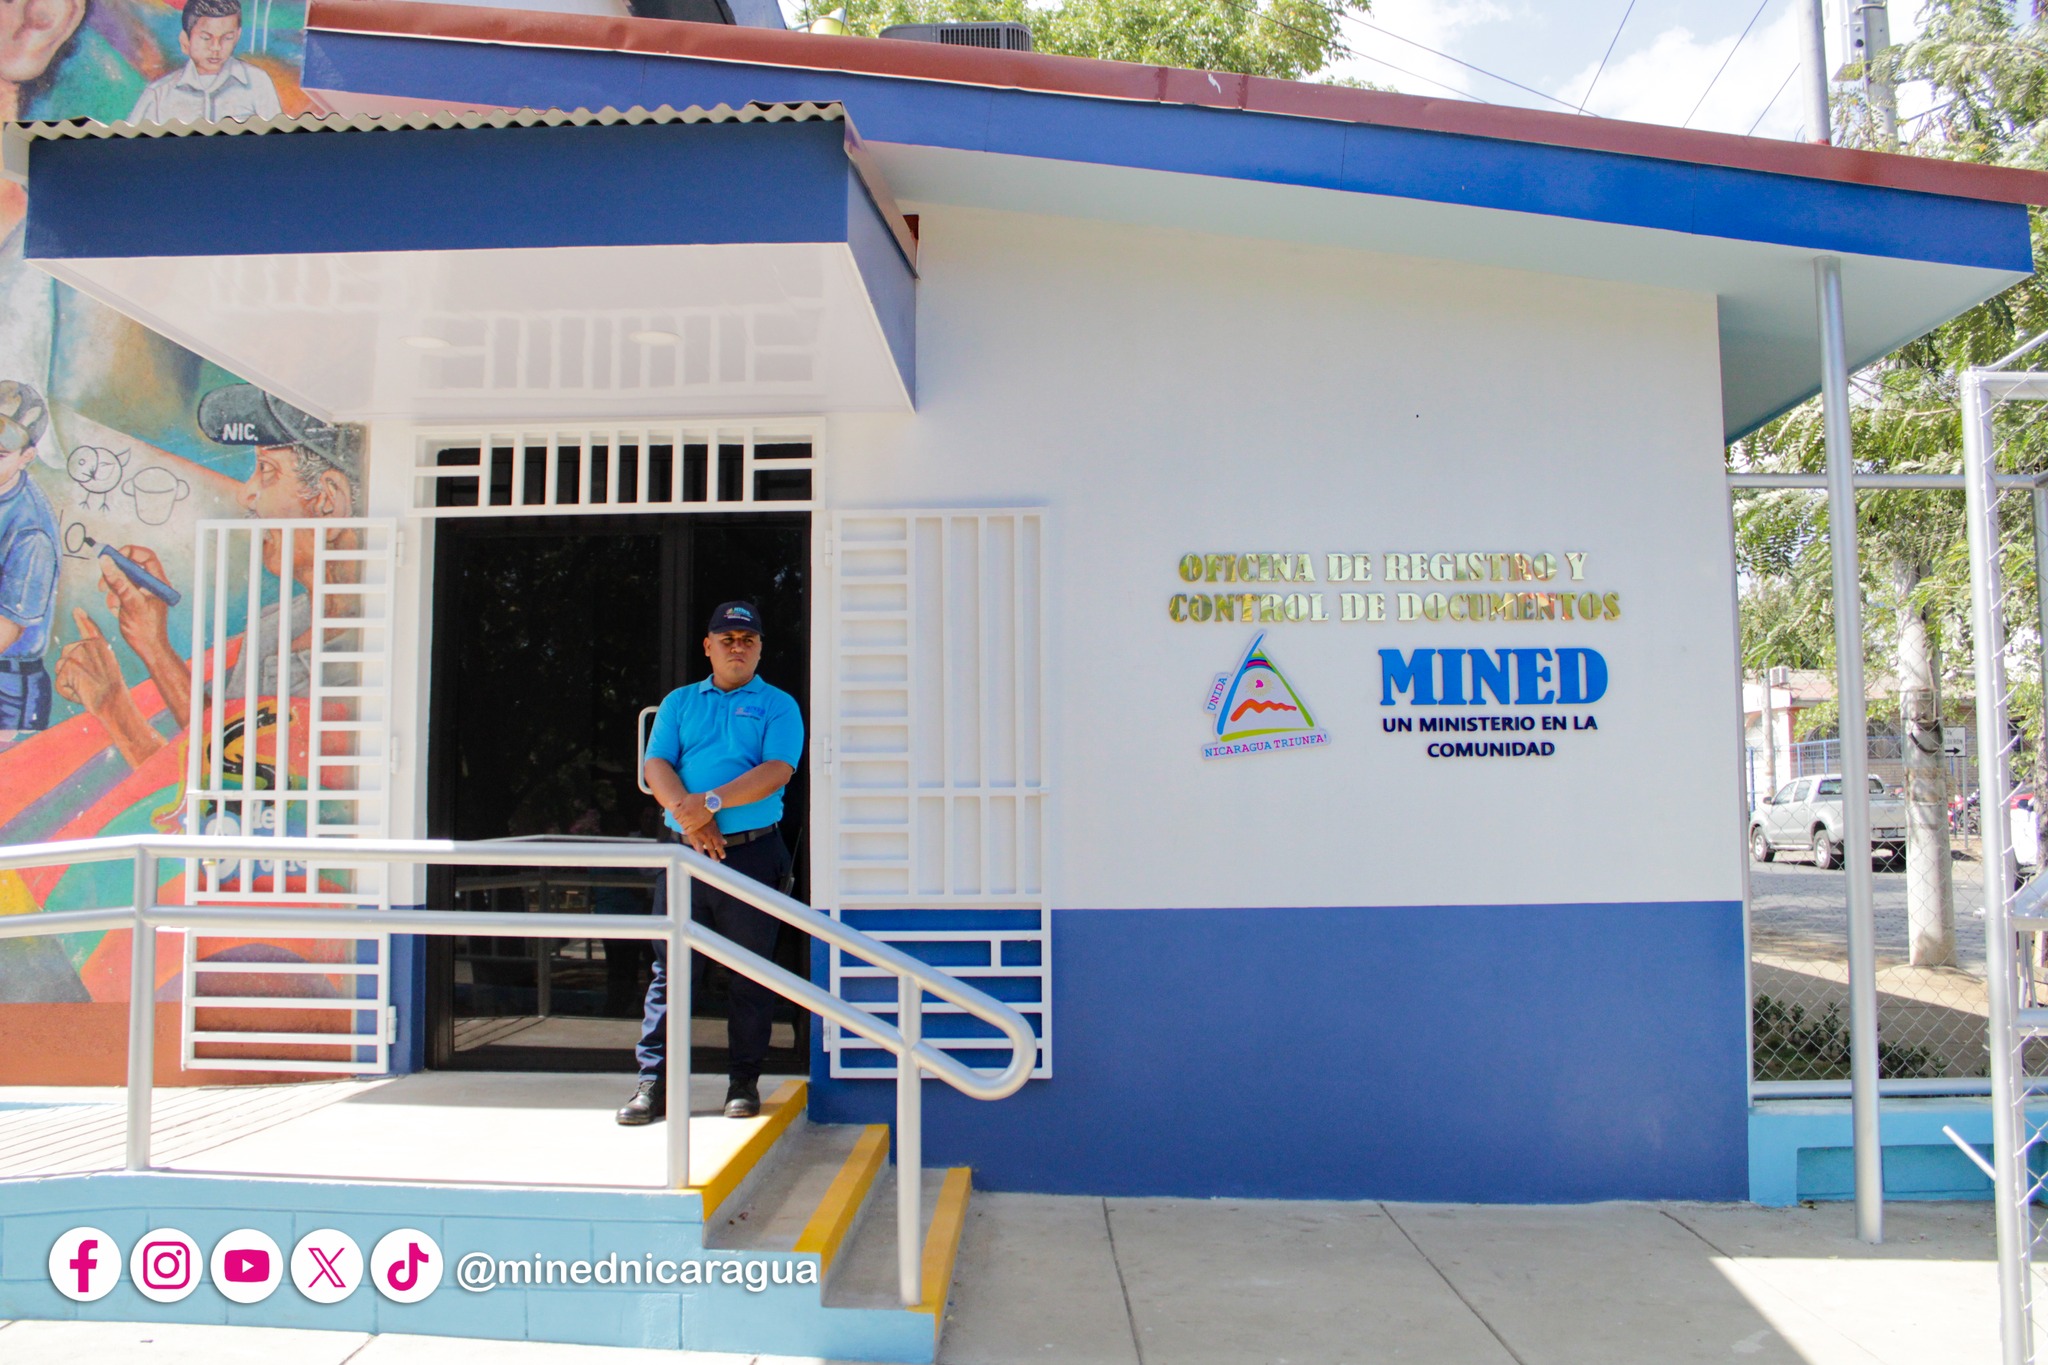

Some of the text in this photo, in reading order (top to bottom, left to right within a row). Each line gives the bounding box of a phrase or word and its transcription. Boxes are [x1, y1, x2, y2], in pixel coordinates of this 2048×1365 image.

[222, 422, 259, 442] NIC.
[1179, 552, 1588, 582] OFICINA DE REGISTRO Y
[1169, 591, 1621, 622] CONTROL DE DOCUMENTOS
[1378, 647, 1608, 706] MINED
[1207, 677, 1228, 711] UNIDA
[1383, 716, 1598, 732] UN MINISTERIO EN LA
[1205, 734, 1328, 757] NICARAGUA TRIUNFA!
[1427, 742, 1556, 757] COMUNIDAD
